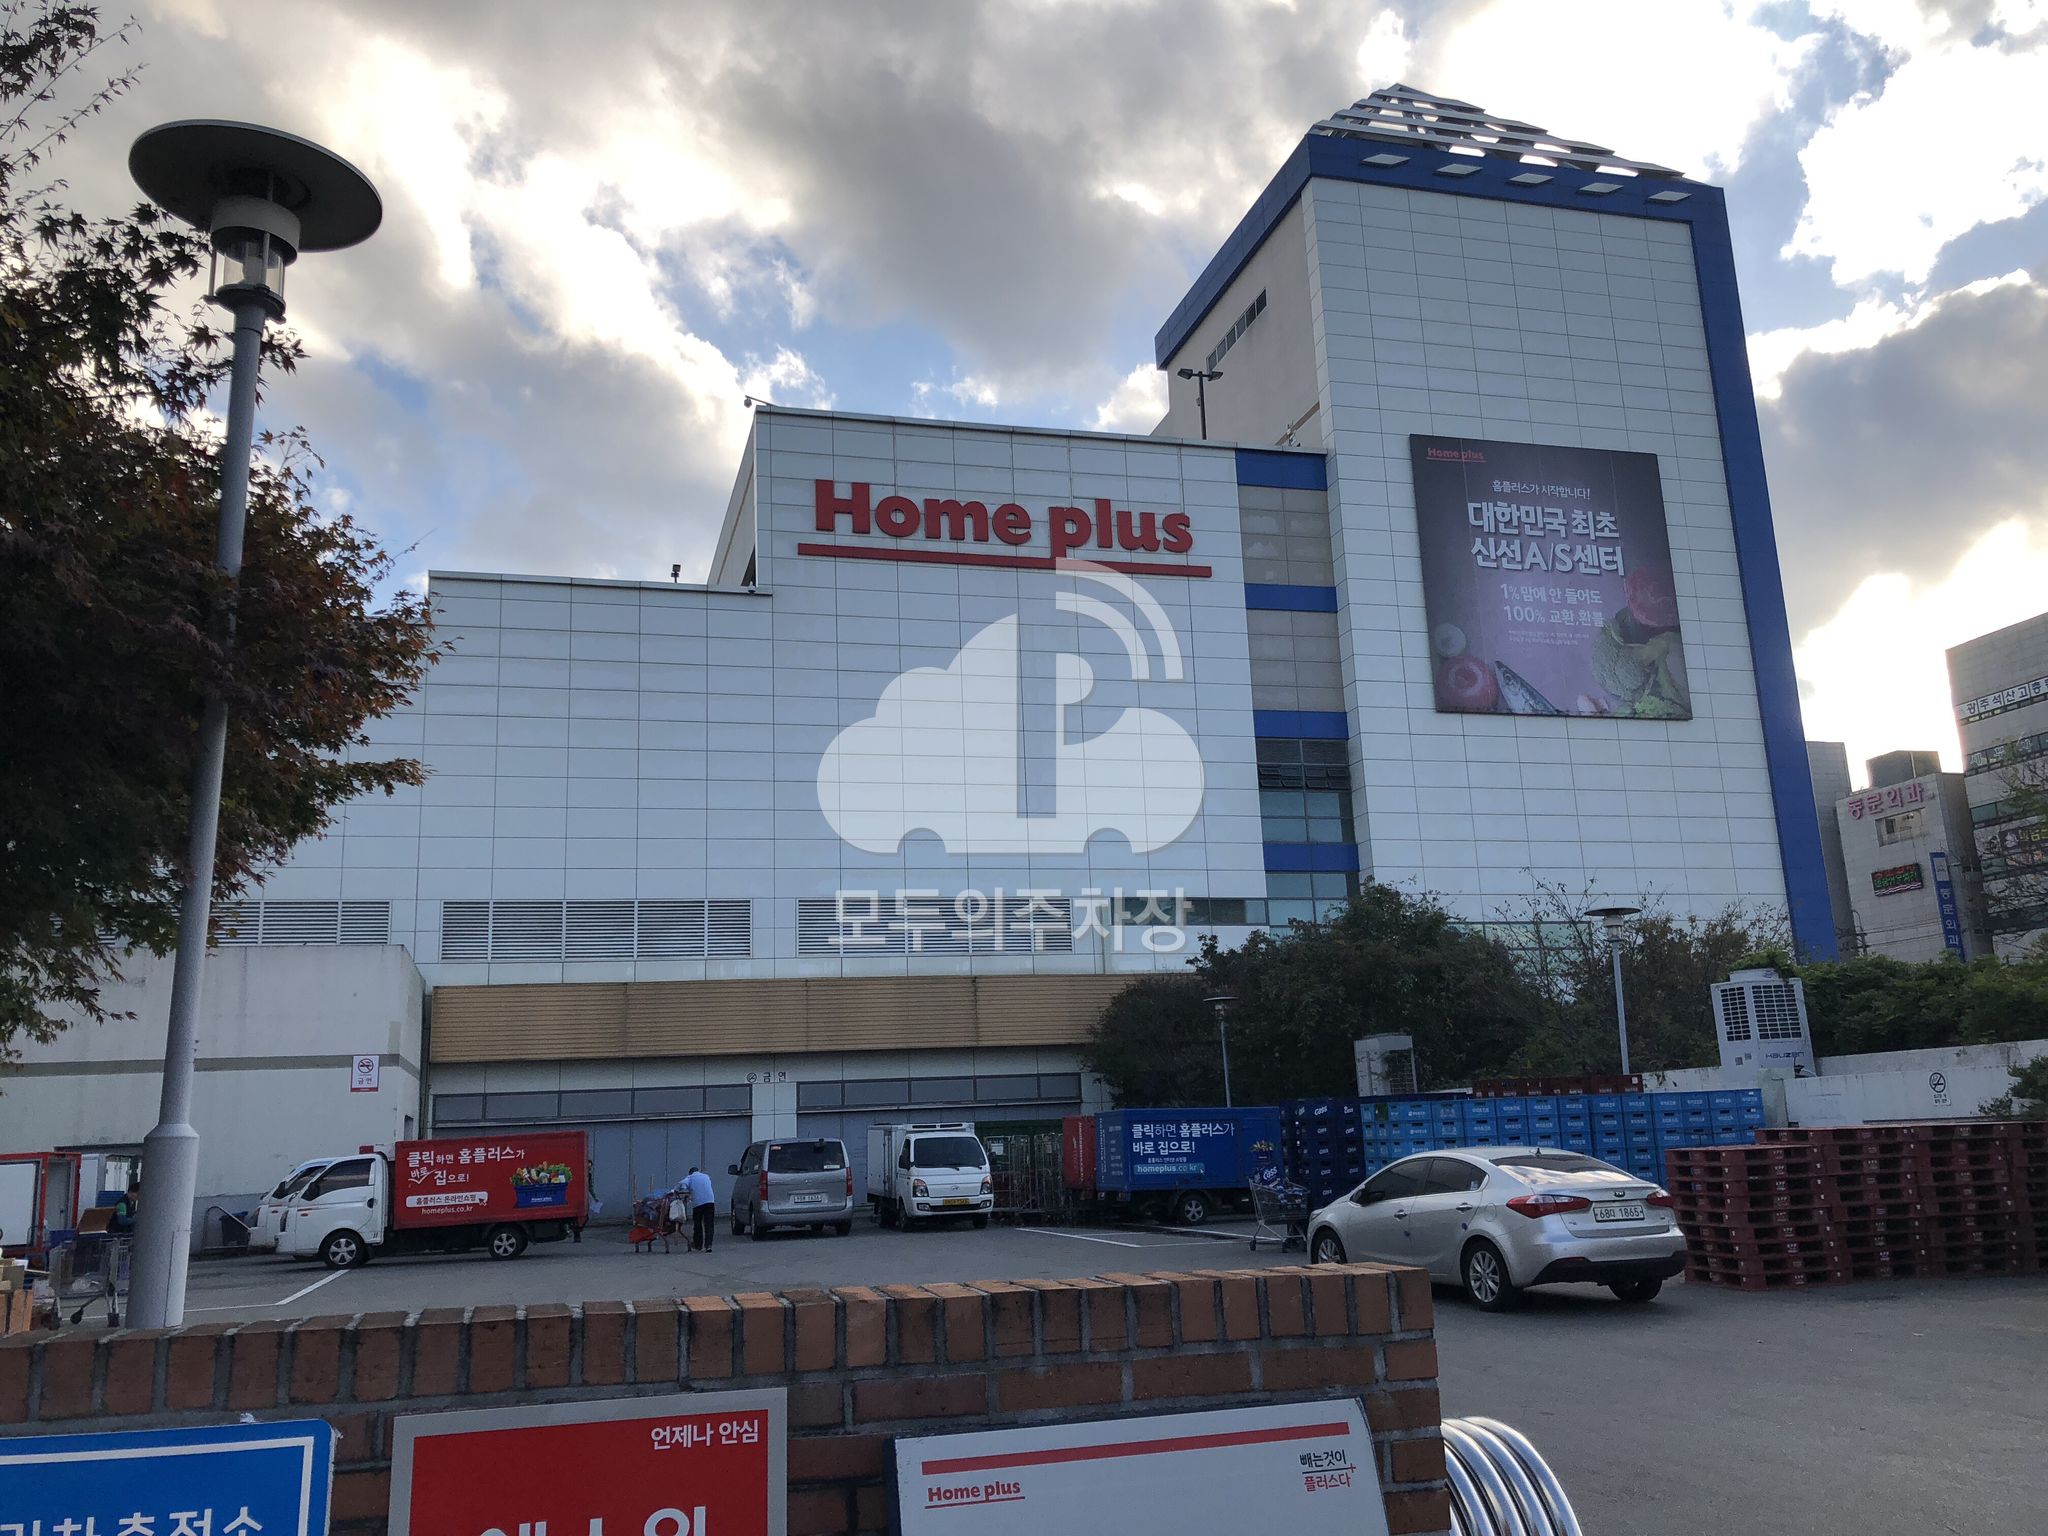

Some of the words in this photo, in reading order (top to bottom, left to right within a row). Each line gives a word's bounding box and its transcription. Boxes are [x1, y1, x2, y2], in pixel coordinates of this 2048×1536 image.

[1428, 447, 1460, 458] Home
[1462, 450, 1484, 460] plus
[1492, 480, 1539, 495] 홈플러스가
[1541, 485, 1591, 500] 시작합니다!
[815, 479, 1032, 545] Home
[1048, 498, 1194, 558] plus
[1467, 501, 1568, 538] 대한민국
[1571, 509, 1620, 540] 최초
[1470, 537, 1625, 576] 신선A/S센터
[1549, 588, 1562, 604] 안
[1564, 588, 1603, 604] 들어도
[1503, 605, 1545, 624] 100%
[1132, 1123, 1176, 1139] 클릭하면
[1179, 1122, 1235, 1138] 홈플러스가
[407, 1151, 454, 1168] 클릭하면
[458, 1146, 525, 1164] 홈플러스가
[1132, 1141, 1156, 1156] 바로
[1158, 1141, 1196, 1155] 집으로!
[411, 1166, 428, 1179] 바로
[434, 1170, 470, 1186] 집으로!
[1618, 1207, 1640, 1218] 1865
[651, 1423, 714, 1450] 언제나
[718, 1419, 759, 1444] 안심
[1299, 1449, 1347, 1468] 빼는것이
[928, 1485, 981, 1502] Home
[983, 1481, 1021, 1501] plus
[1304, 1472, 1351, 1492] 플러스다
